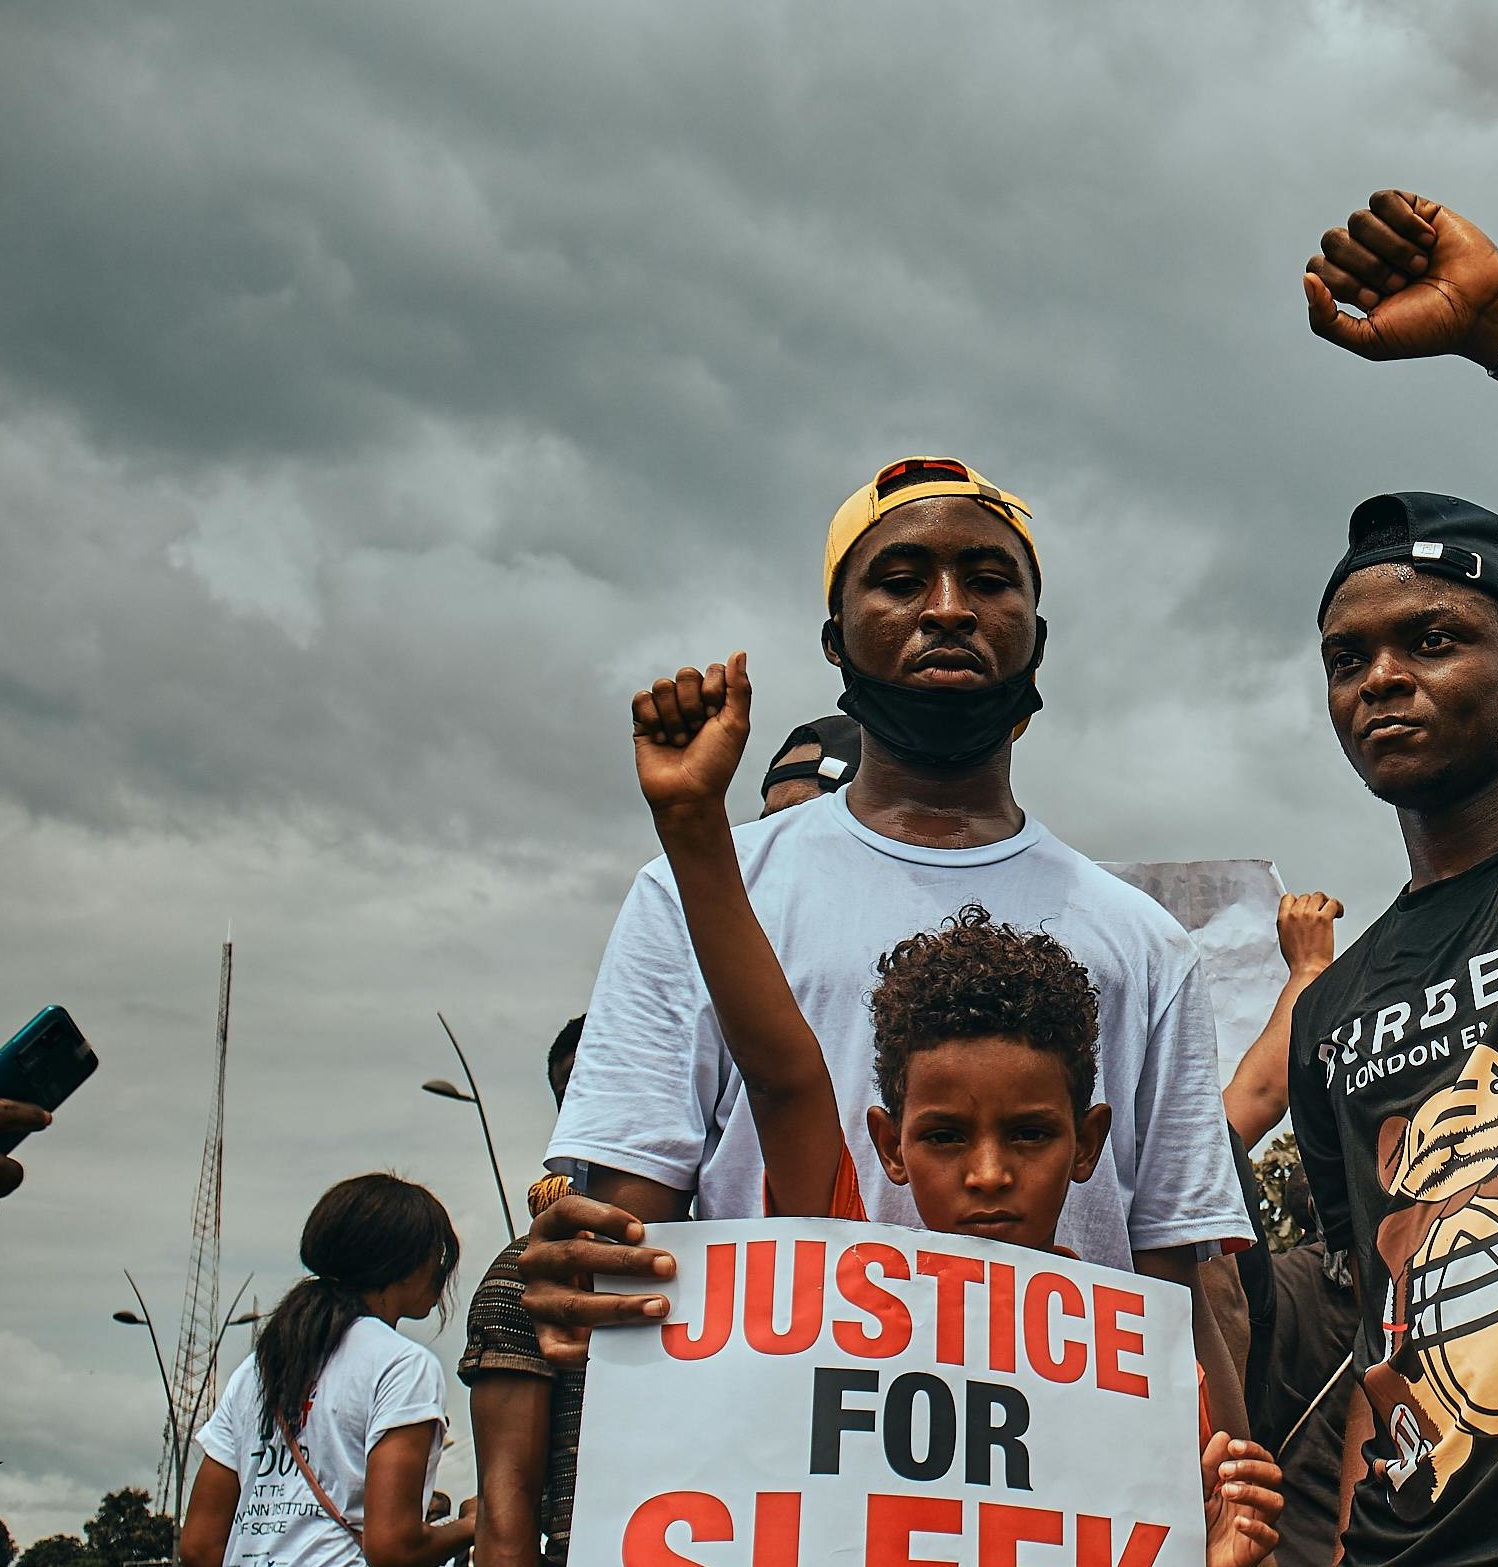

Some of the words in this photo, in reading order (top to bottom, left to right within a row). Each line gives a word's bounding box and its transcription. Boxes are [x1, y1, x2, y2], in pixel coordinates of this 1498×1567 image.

[1345, 1035, 1451, 1096] LONDON
[661, 1239, 1150, 1399] JUSTICE
[809, 1367, 1034, 1492] FOR
